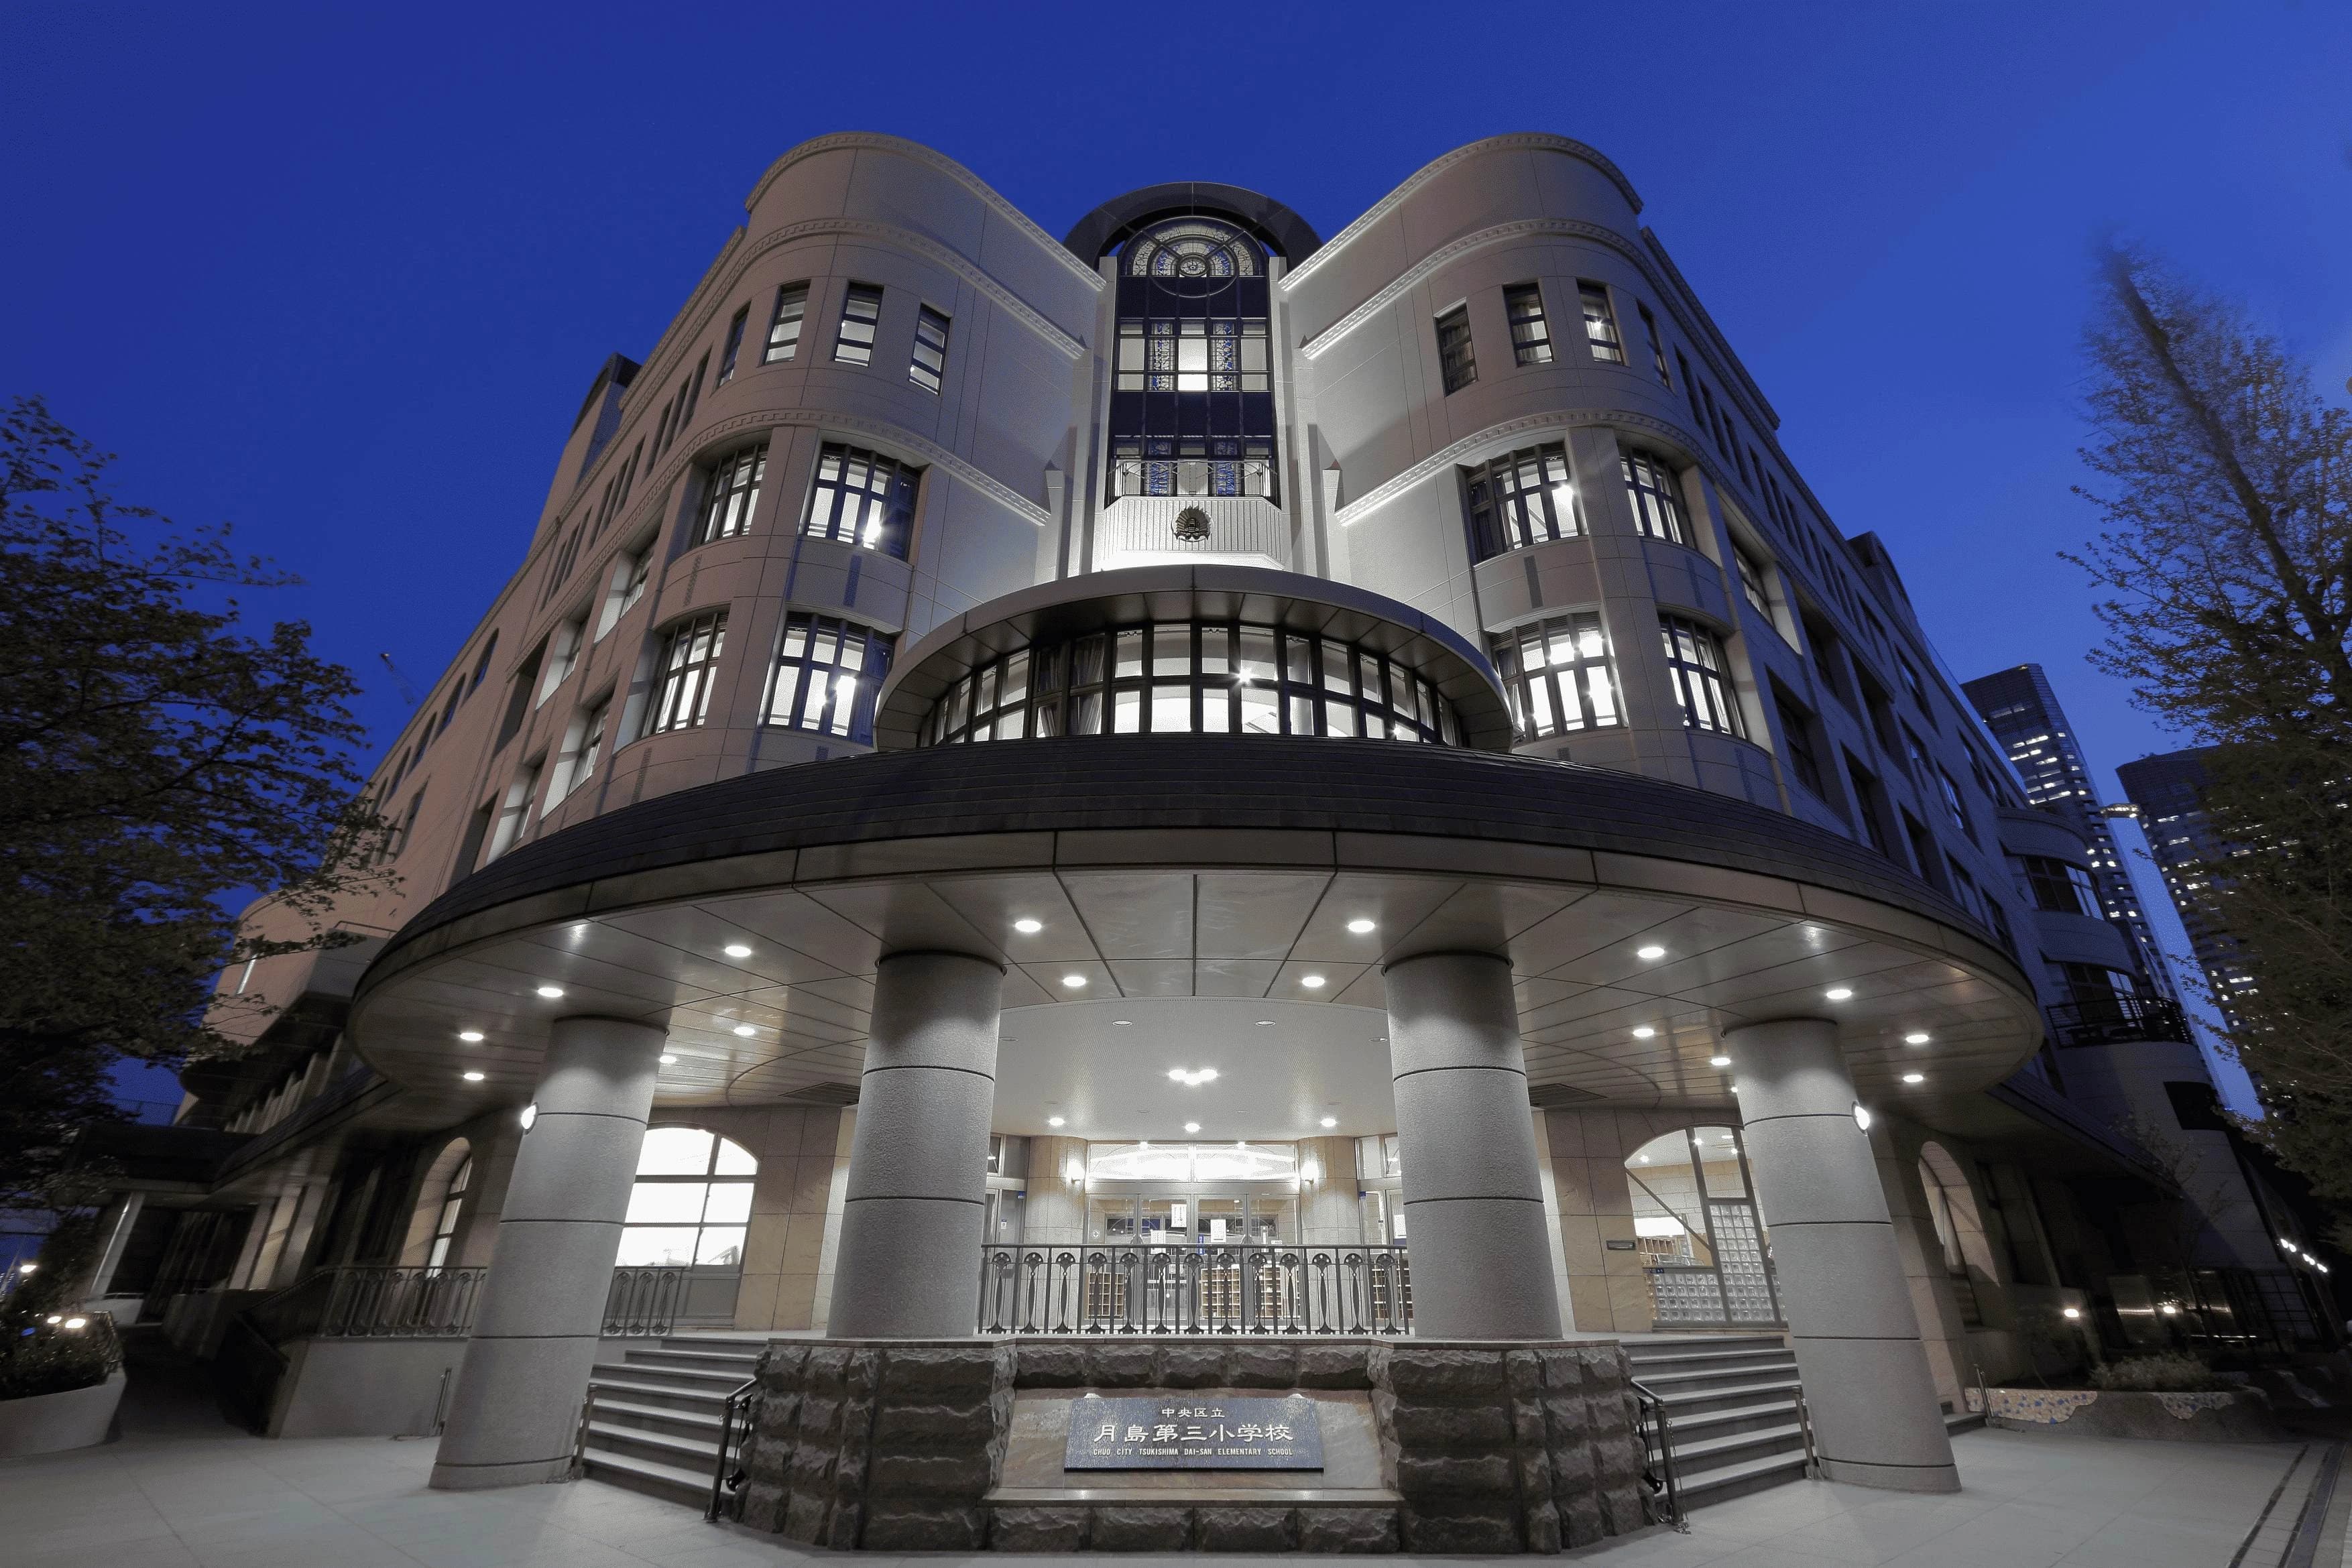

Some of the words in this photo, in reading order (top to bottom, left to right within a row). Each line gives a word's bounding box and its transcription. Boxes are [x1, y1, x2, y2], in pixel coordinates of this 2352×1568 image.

[1161, 1407, 1226, 1419] 中央区立
[1094, 1424, 1294, 1443] 月島第三小学校
